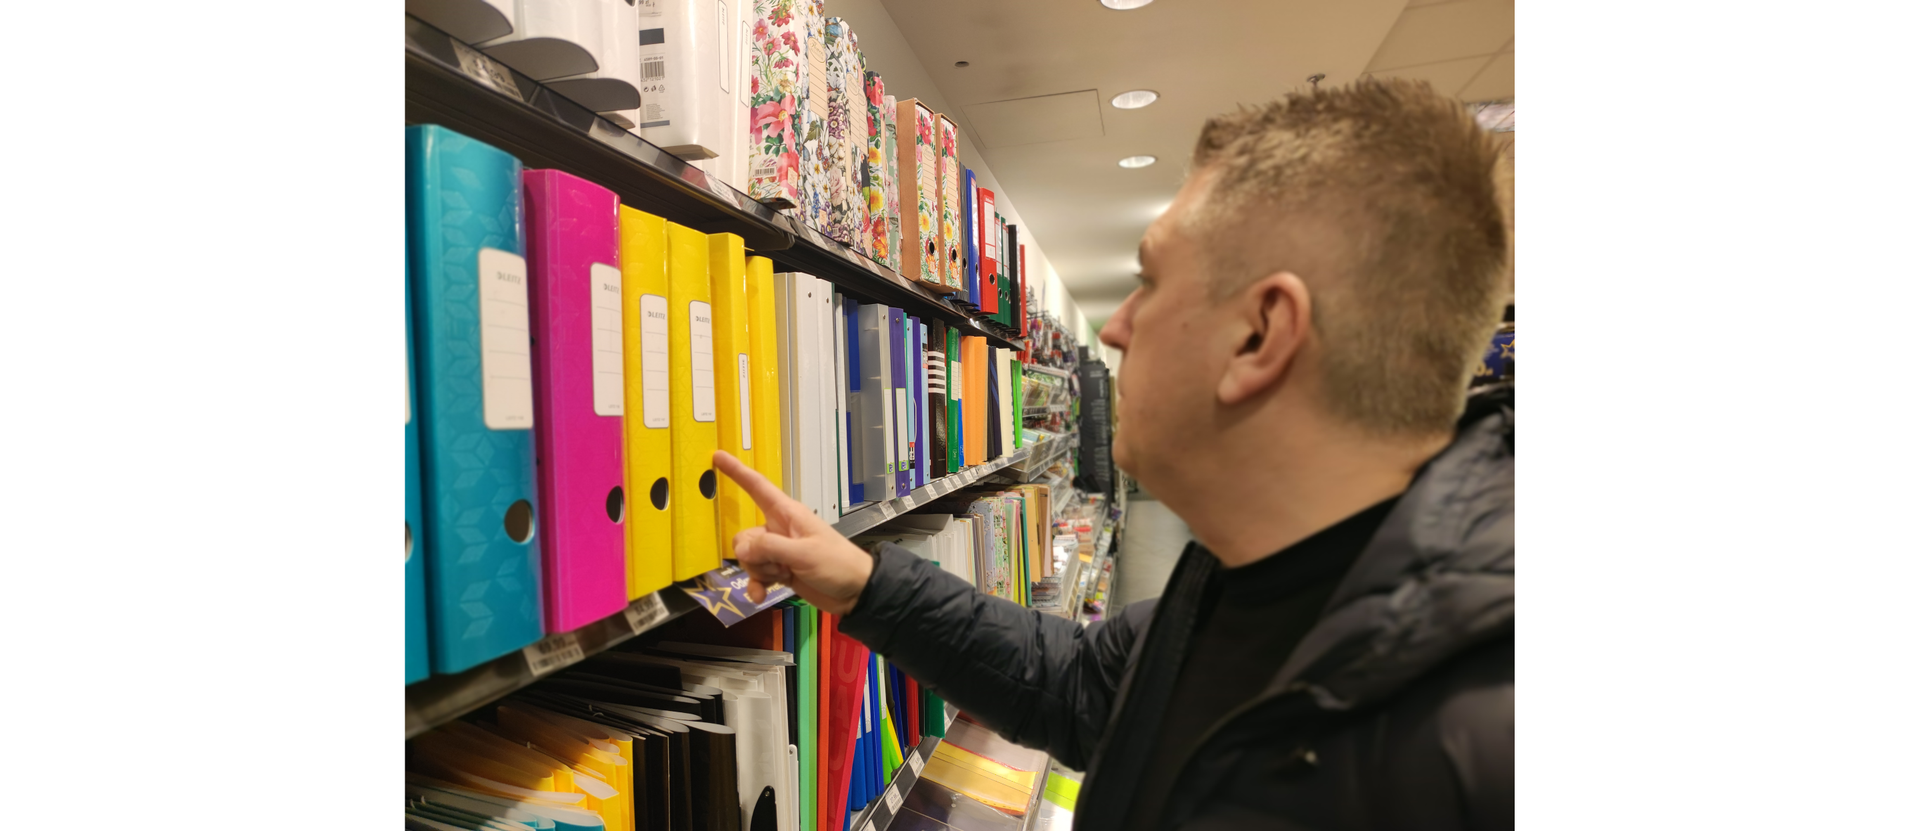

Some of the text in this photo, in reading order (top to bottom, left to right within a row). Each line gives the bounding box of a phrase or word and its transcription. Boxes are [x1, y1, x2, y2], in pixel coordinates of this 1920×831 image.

[502, 272, 522, 285] LEITZ
[607, 284, 620, 294] LEITZ
[651, 311, 666, 320] LEITZ
[698, 316, 710, 324] LEITZ
